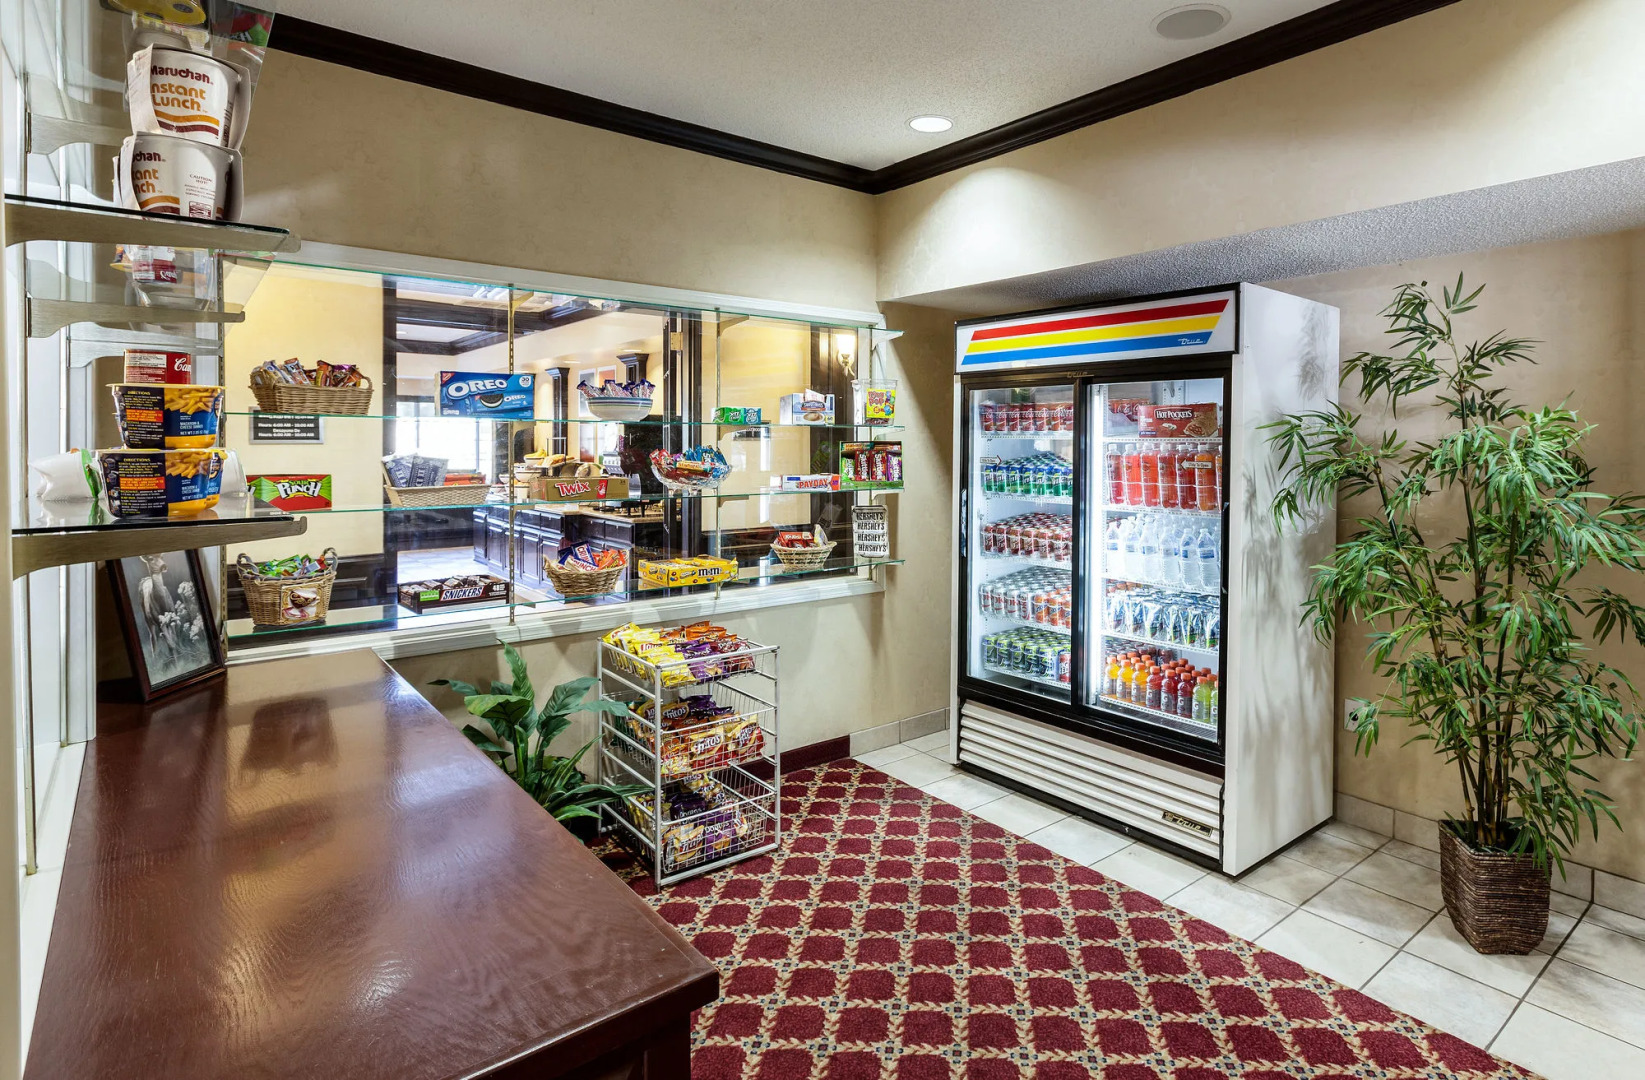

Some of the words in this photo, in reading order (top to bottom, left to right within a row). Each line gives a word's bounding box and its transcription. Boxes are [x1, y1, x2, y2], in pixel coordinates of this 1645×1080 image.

[151, 65, 210, 84] Maruchan
[151, 83, 206, 100] nstant
[152, 94, 201, 112] Lunch
[447, 379, 507, 397] OREO
[1156, 410, 1167, 419] HOT
[1167, 409, 1193, 419] POCKETS
[276, 481, 321, 499] PUNCH
[555, 481, 590, 497] Twix
[798, 479, 828, 488] PAYDAY
[443, 586, 482, 600] SNICKERS
[663, 706, 686, 719] Fritos
[694, 735, 720, 753] Fritos
